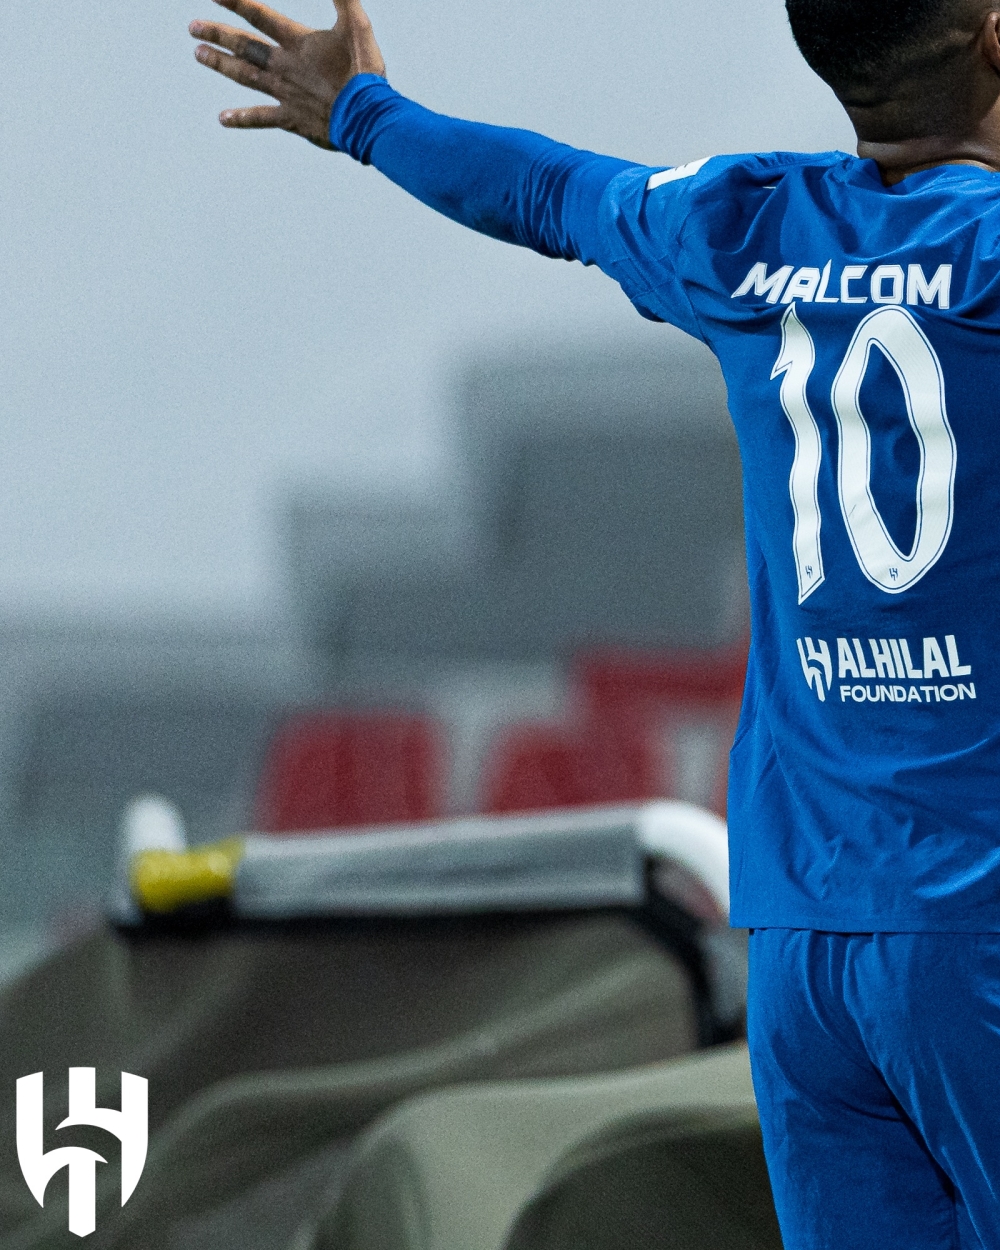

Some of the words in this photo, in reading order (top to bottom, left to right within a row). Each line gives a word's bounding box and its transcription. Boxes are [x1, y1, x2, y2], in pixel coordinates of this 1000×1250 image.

[731, 259, 952, 309] MALCOM
[770, 301, 957, 605] 10
[840, 682, 977, 703] FOUNDATION
